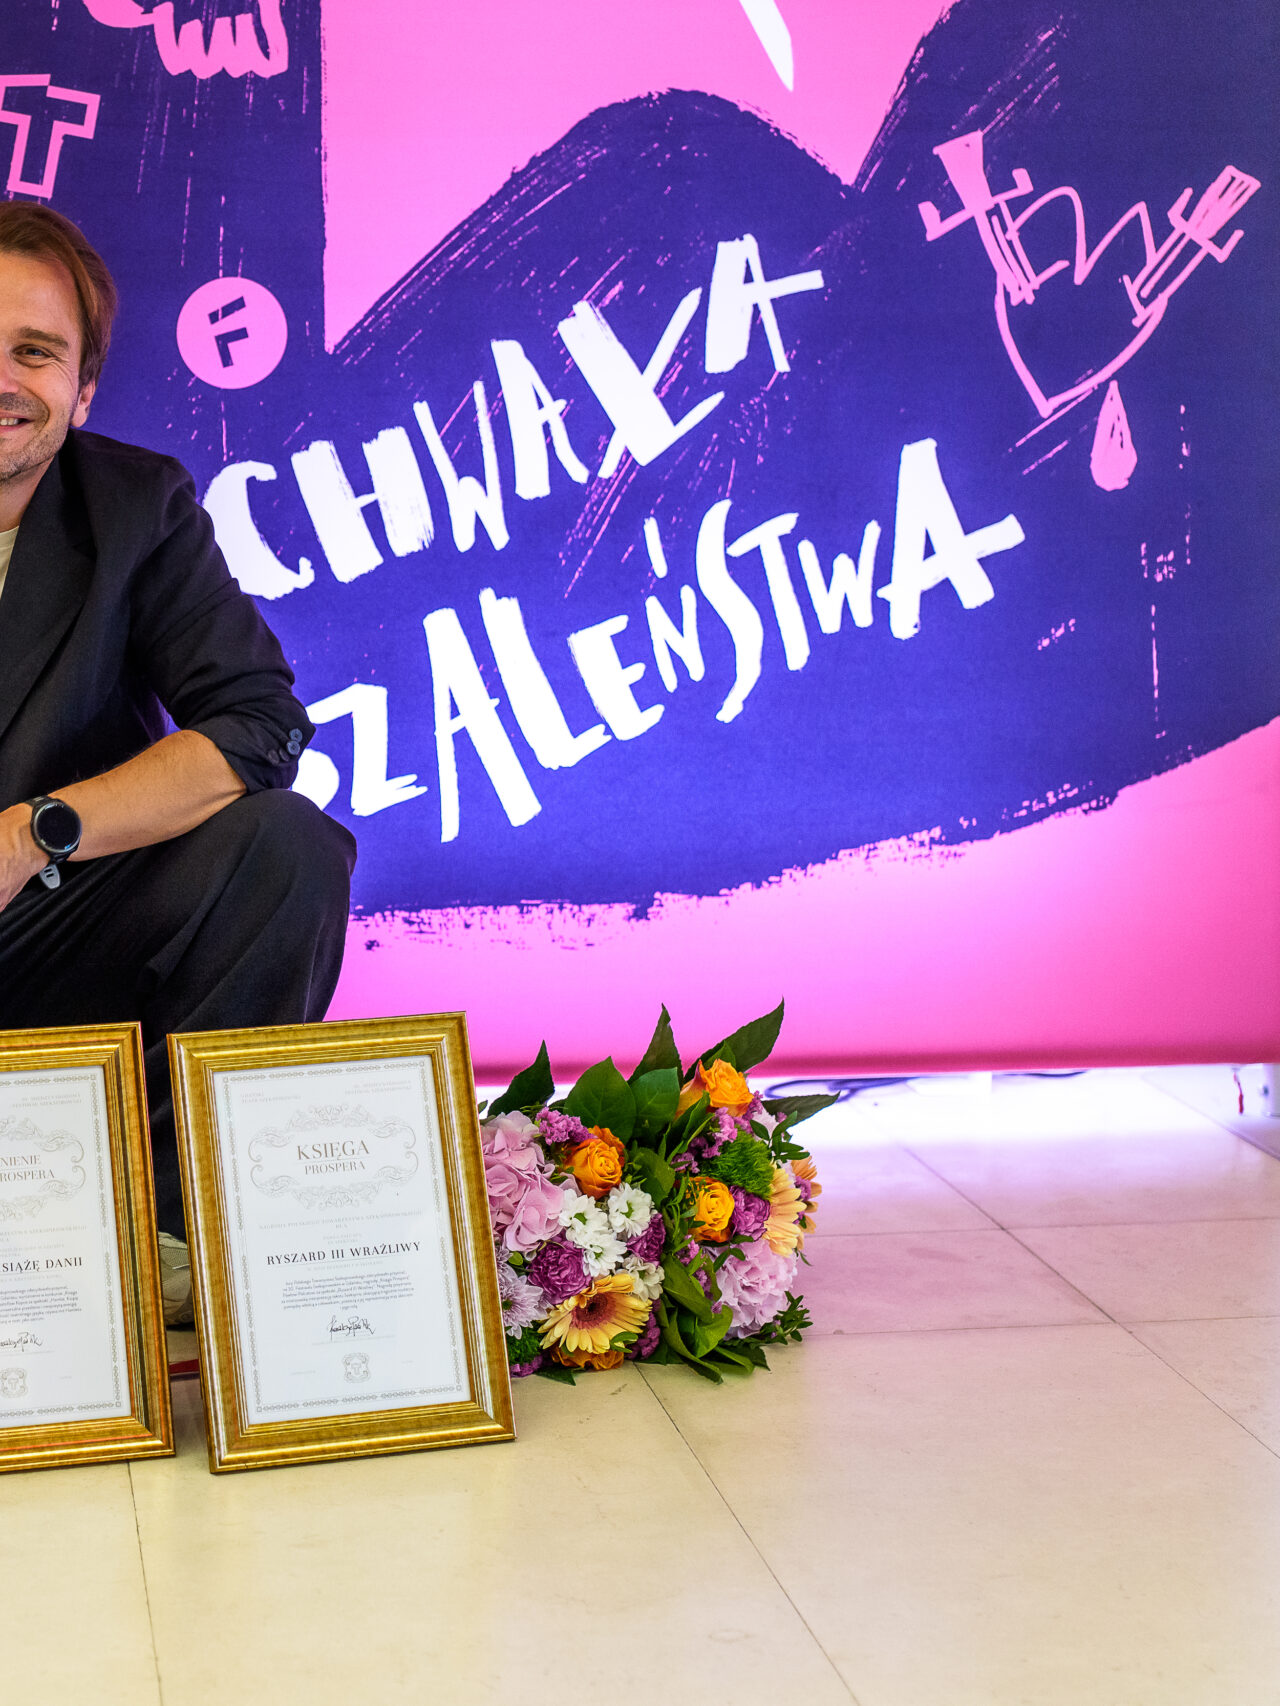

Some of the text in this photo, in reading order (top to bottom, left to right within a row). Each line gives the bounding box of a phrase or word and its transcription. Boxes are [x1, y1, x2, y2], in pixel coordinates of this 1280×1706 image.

[202, 233, 825, 600] CHWAŁA
[296, 1139, 370, 1161] KSIĘGA
[304, 1160, 367, 1175] PROSPERA
[45, 1256, 83, 1270] DANII
[266, 1250, 327, 1266] RYSZARD
[330, 1248, 345, 1260] III
